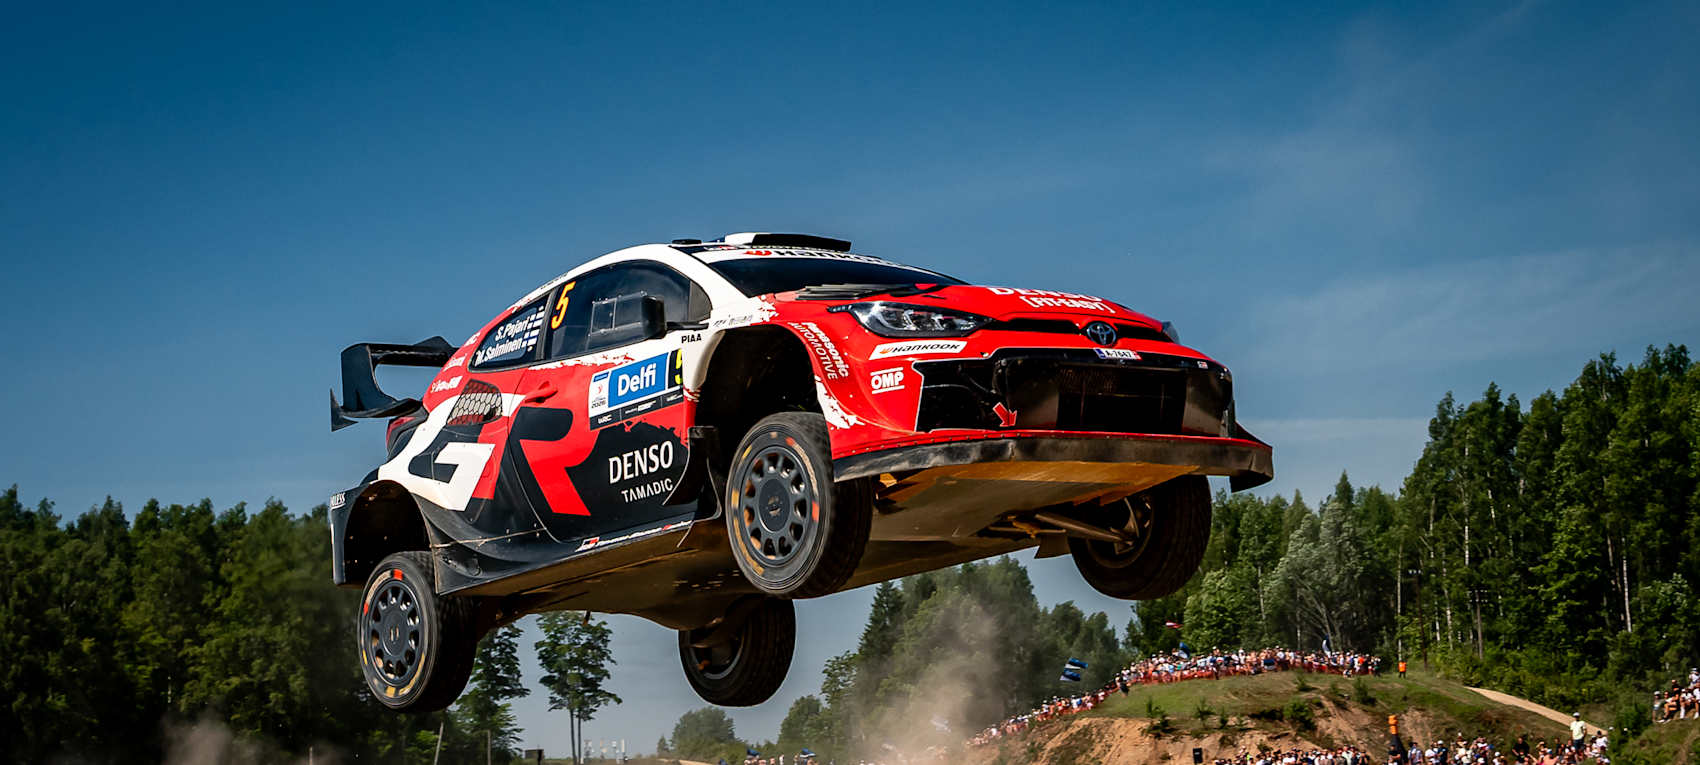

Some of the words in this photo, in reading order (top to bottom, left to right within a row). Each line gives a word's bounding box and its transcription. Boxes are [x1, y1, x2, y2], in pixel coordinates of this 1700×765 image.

[551, 279, 577, 329] 5
[681, 333, 702, 344] PIAA
[787, 322, 838, 380] AUTOMOTIVE
[801, 322, 849, 377] Panasonic
[617, 363, 656, 397] Delfi
[871, 371, 904, 389] OMP
[608, 440, 674, 485] DENSO
[621, 478, 673, 503] TAMADIC
